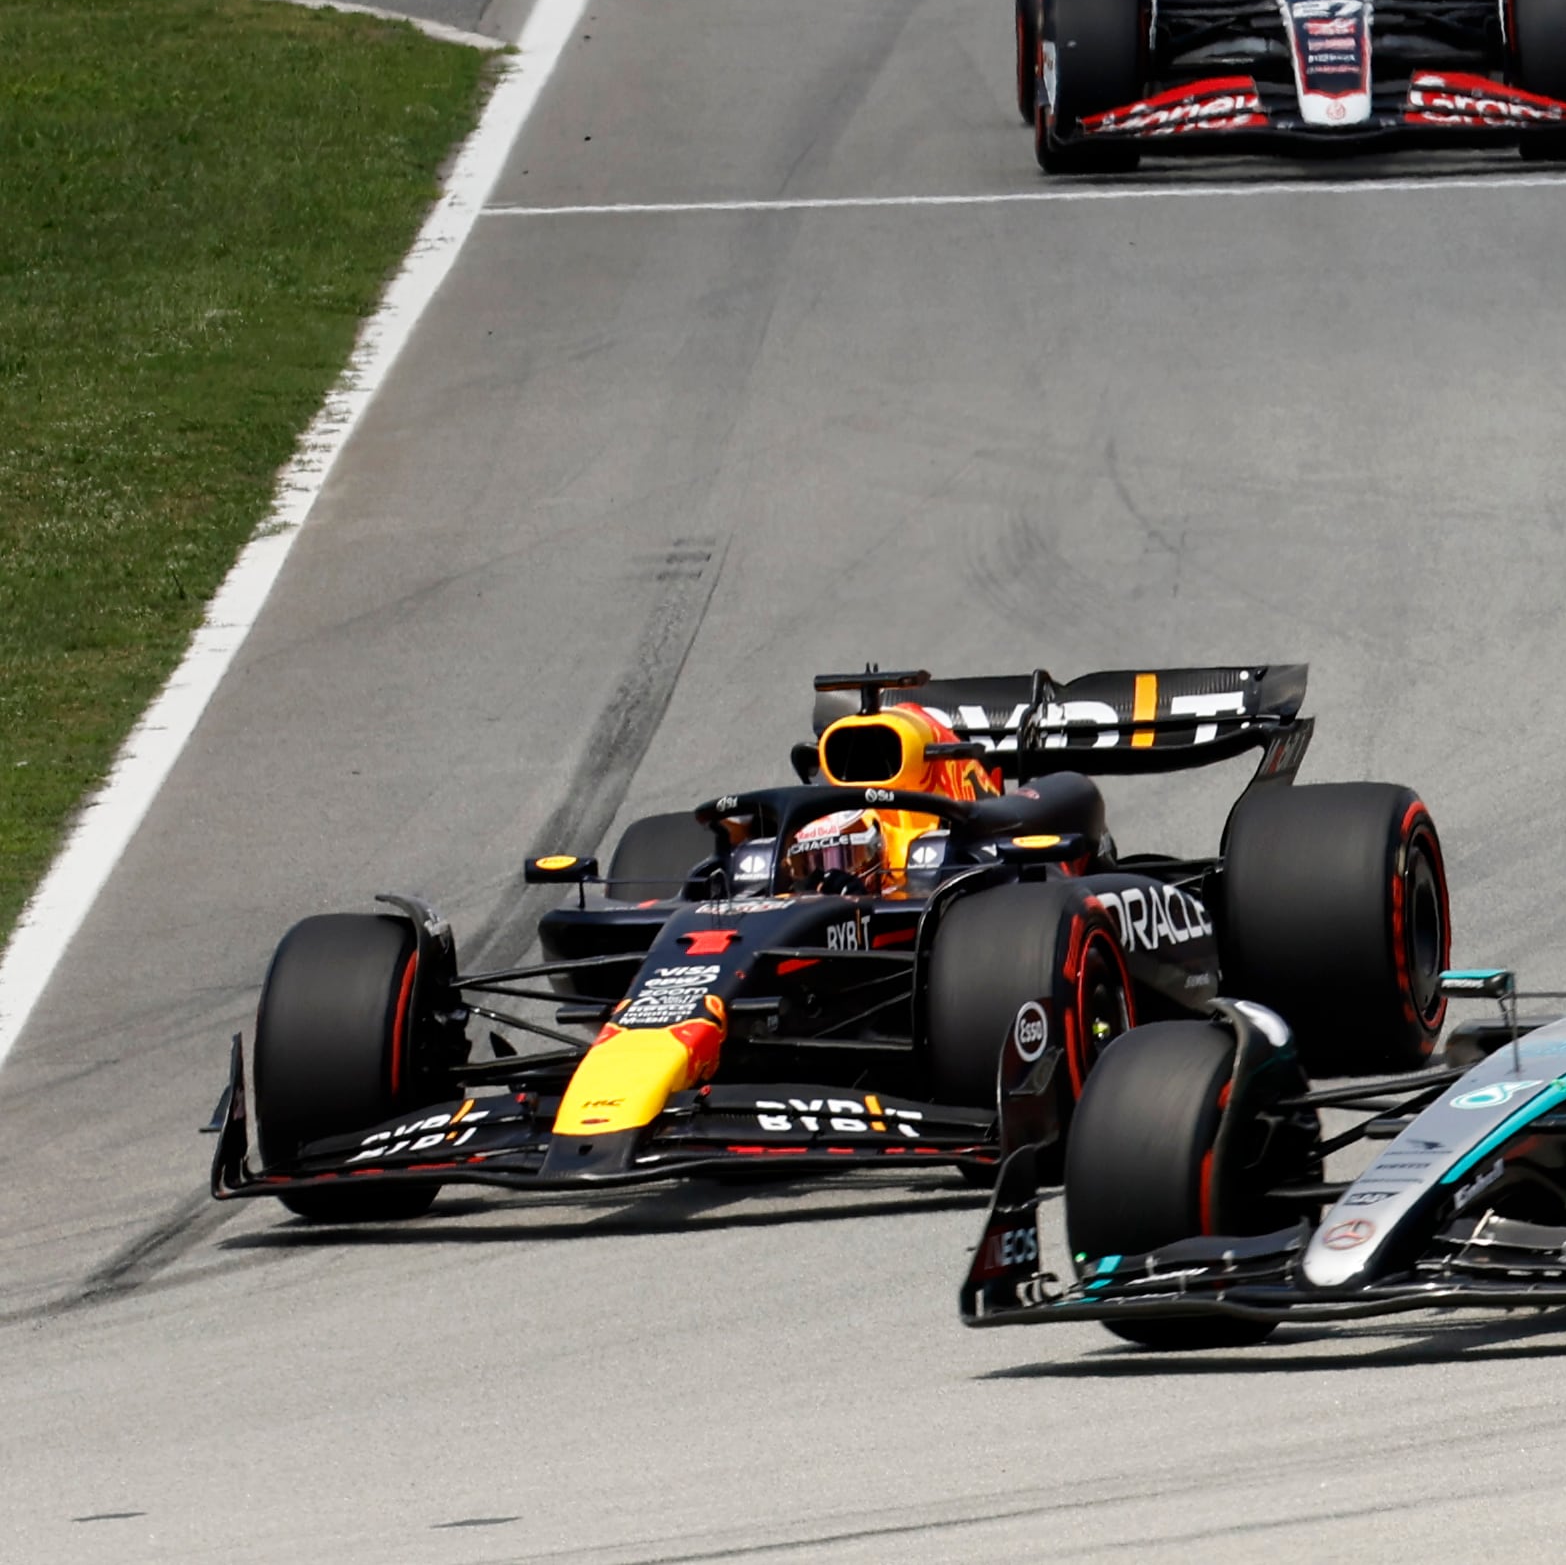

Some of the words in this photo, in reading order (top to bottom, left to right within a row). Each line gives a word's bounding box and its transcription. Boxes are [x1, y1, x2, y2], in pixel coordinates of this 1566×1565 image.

[827, 908, 872, 953] BYBIT
[681, 929, 739, 955] 1
[654, 964, 721, 977] VISA
[638, 987, 709, 998] zoom
